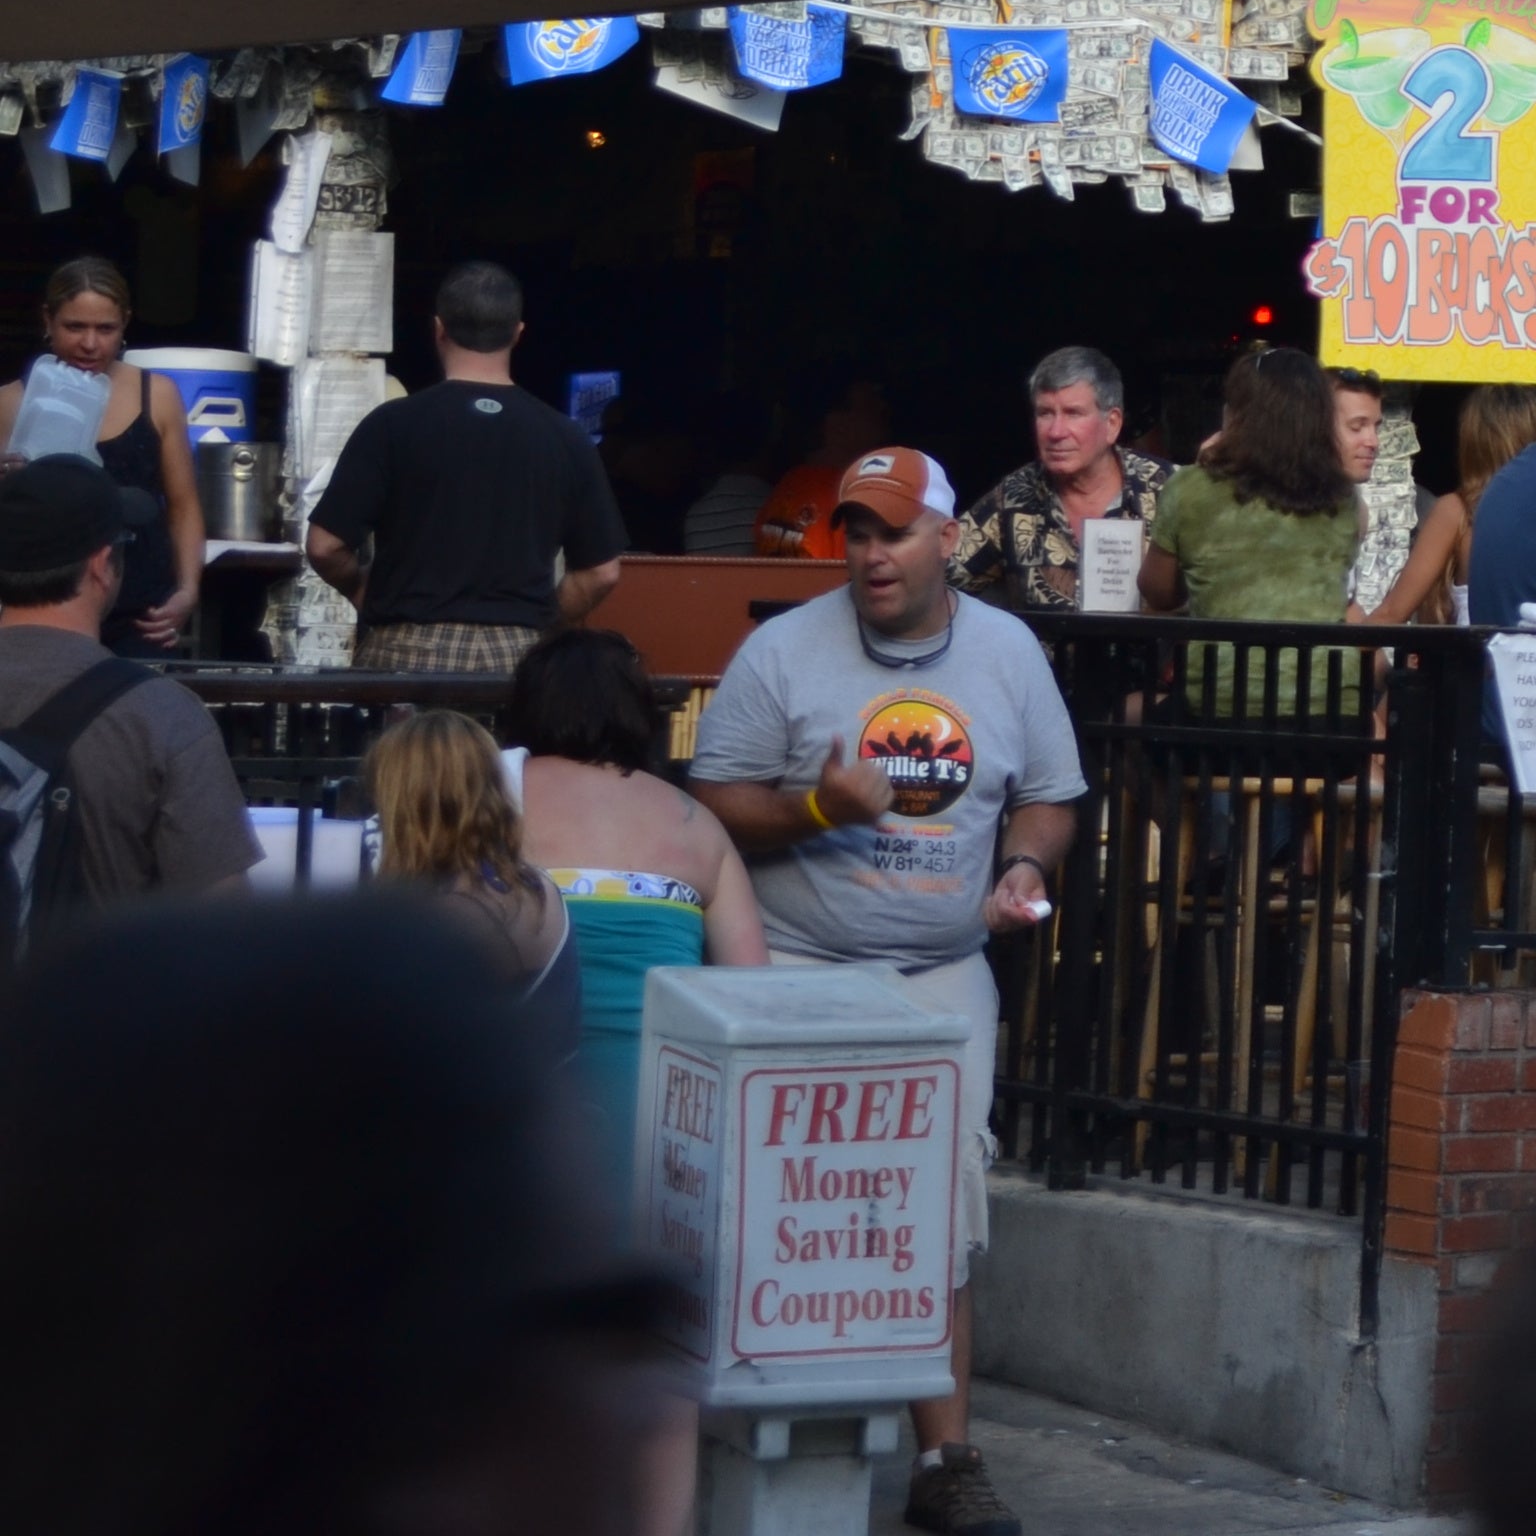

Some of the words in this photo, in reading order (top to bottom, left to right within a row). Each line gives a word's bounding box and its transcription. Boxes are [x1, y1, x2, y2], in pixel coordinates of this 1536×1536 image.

[1163, 62, 1228, 120] DRINK
[1402, 47, 1497, 181] 2
[1401, 185, 1499, 225] FOR
[1309, 221, 1408, 340] $10
[935, 758, 967, 781] T's
[874, 853, 893, 870] W
[875, 837, 891, 853] N
[661, 1063, 718, 1146] FREE
[763, 1076, 939, 1147] FREE
[779, 1157, 916, 1210] Money
[775, 1213, 917, 1273] Saving
[751, 1278, 936, 1338] Coupons
